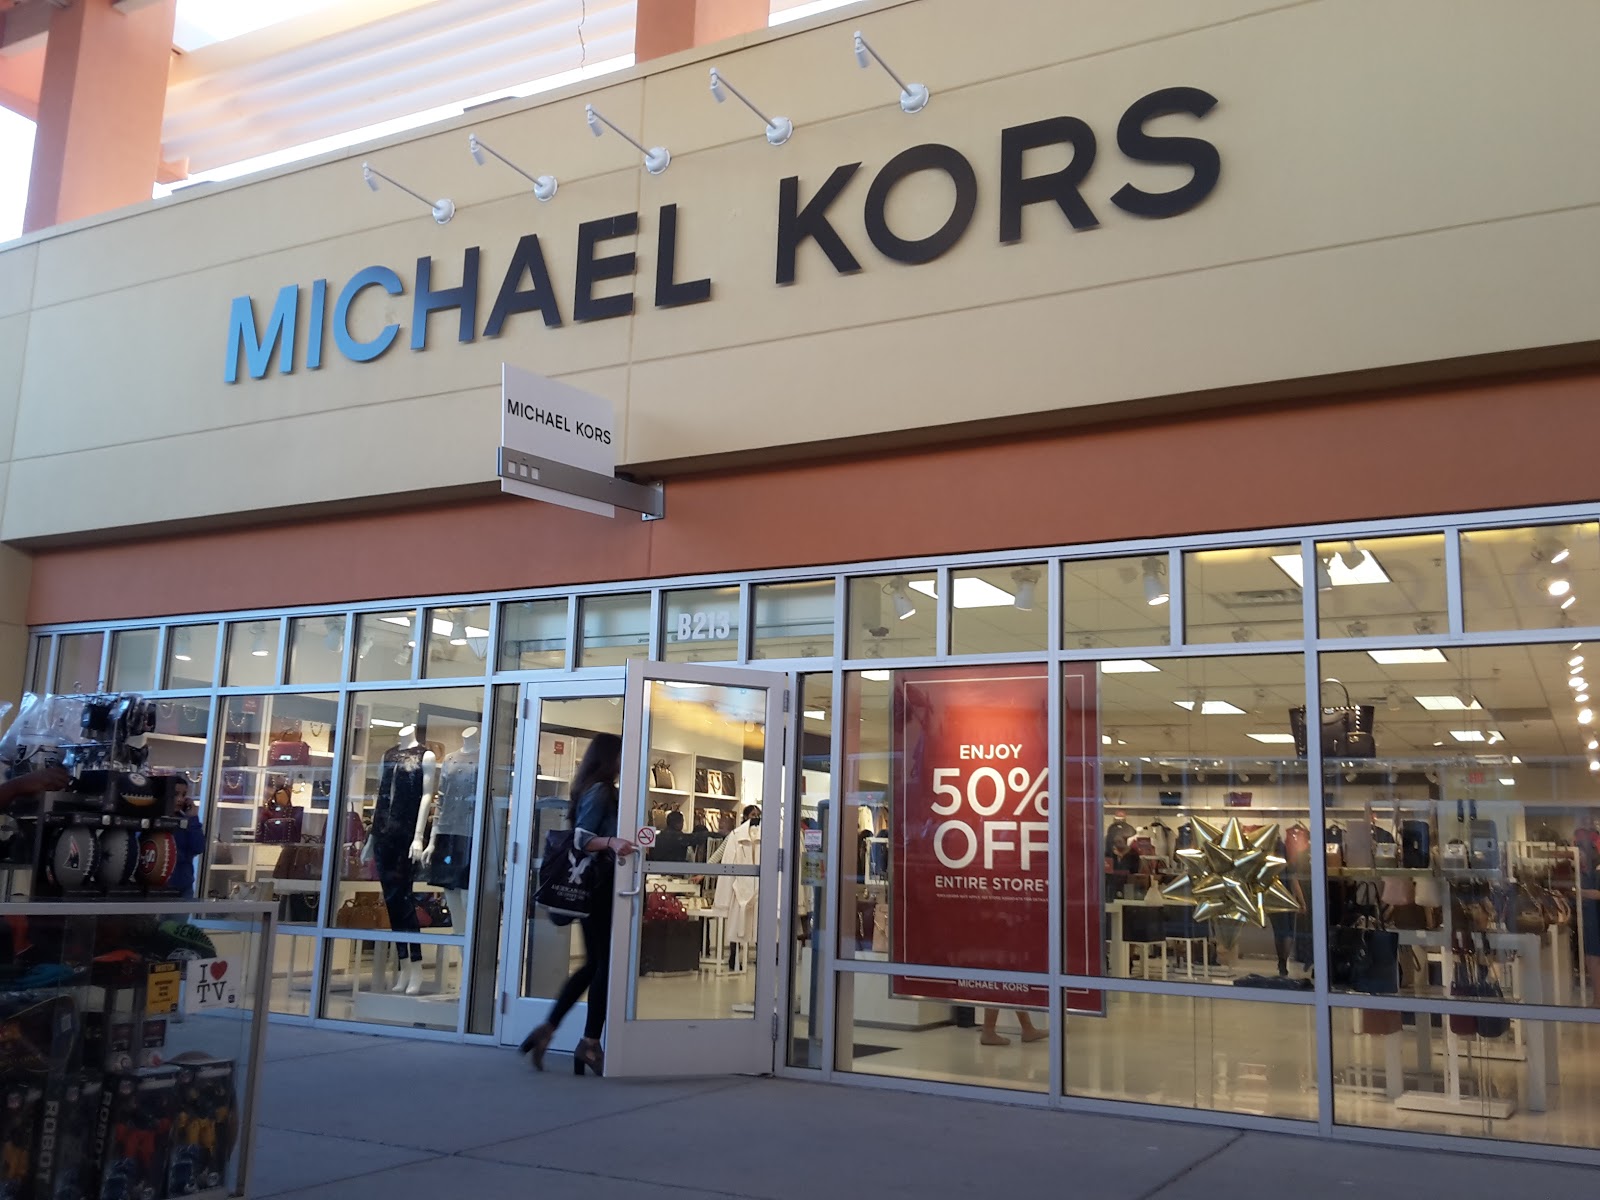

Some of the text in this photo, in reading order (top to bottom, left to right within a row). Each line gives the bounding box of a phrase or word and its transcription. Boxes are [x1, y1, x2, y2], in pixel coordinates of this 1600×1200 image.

[223, 86, 1222, 385] MICHAEL KORS
[507, 399, 611, 445] MICHAEL KORS
[678, 611, 730, 640] B213
[959, 744, 1023, 760] ENJOY
[930, 766, 1049, 816] 50%
[933, 819, 1049, 871] OFF
[934, 875, 988, 890] ENTIRE
[199, 964, 208, 984] I
[957, 980, 1029, 992] MICHAEL KORS
[197, 981, 227, 1004] TV
